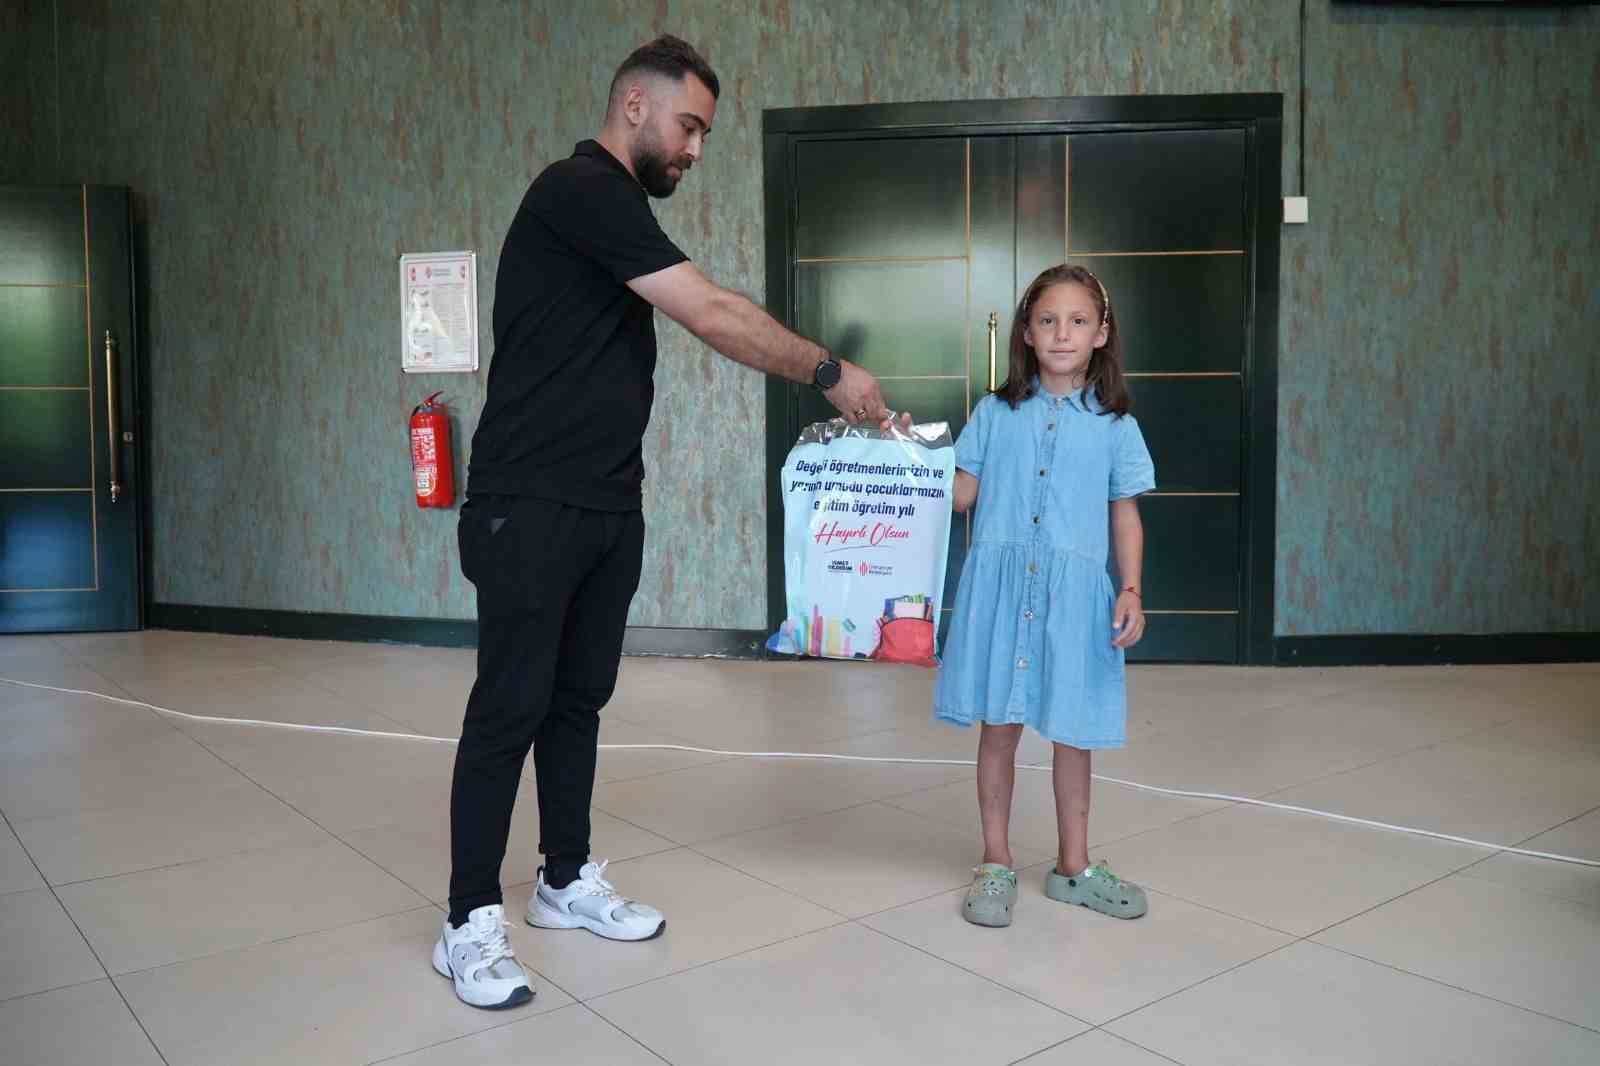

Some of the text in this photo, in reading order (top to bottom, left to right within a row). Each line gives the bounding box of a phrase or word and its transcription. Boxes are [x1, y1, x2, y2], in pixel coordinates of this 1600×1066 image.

[933, 468, 944, 479] ve
[814, 499, 916, 519] eitim öğretim yılı
[869, 522, 910, 545] Olsun
